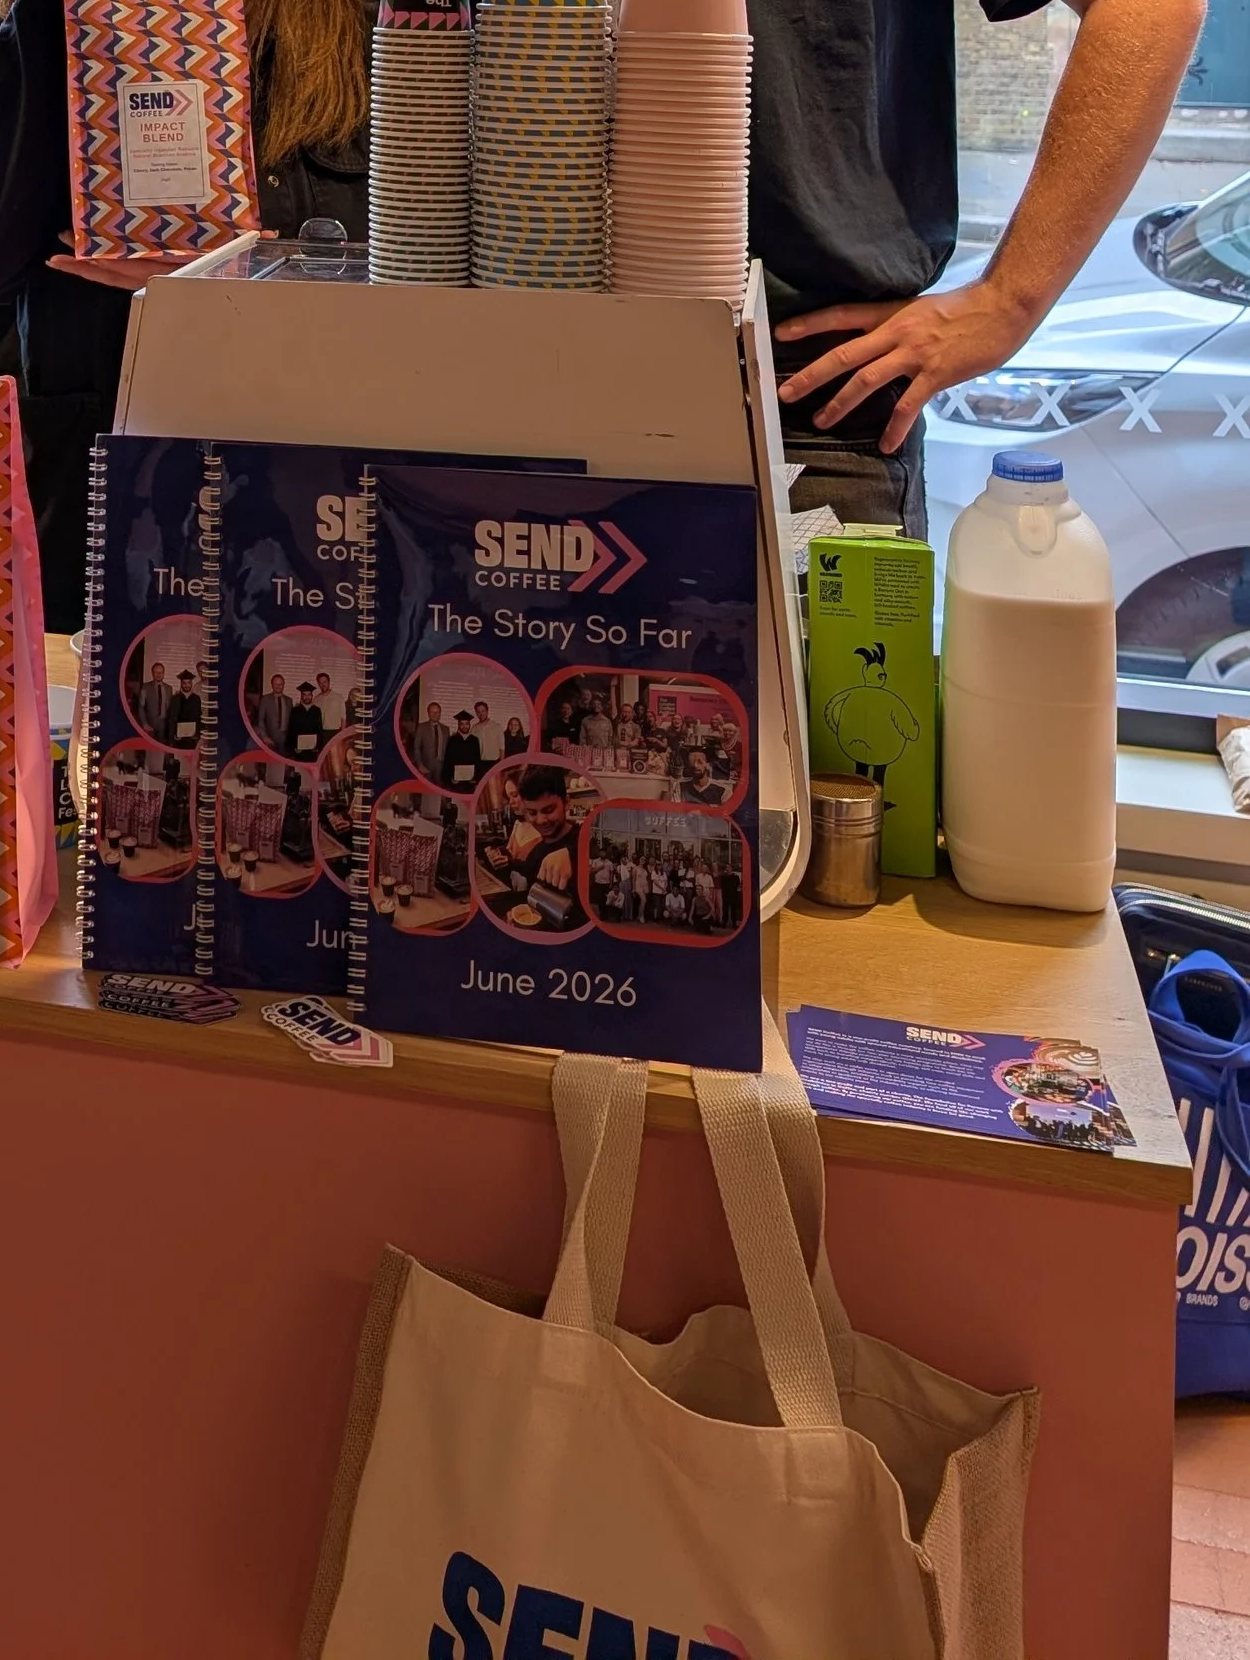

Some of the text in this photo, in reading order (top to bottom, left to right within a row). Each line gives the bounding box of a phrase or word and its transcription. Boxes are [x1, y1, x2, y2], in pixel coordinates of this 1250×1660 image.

[129, 92, 174, 111] SEND
[130, 110, 163, 118] COFFEE
[140, 122, 186, 132] IMPACT
[142, 133, 184, 143] BLEND
[316, 495, 368, 542] SE
[474, 519, 594, 572] SEND
[153, 567, 206, 598] The
[272, 577, 324, 608] The
[475, 570, 561, 592] COFFEE
[427, 603, 692, 650] The Story So Far
[306, 920, 356, 950] Jun
[107, 974, 196, 994] SEND
[460, 959, 637, 1008] June 2026
[269, 1012, 320, 1044] COFFEE
[279, 1000, 361, 1046] SEND
[906, 1027, 962, 1044] SEND
[1186, 1293, 1218, 1307] BRANDS
